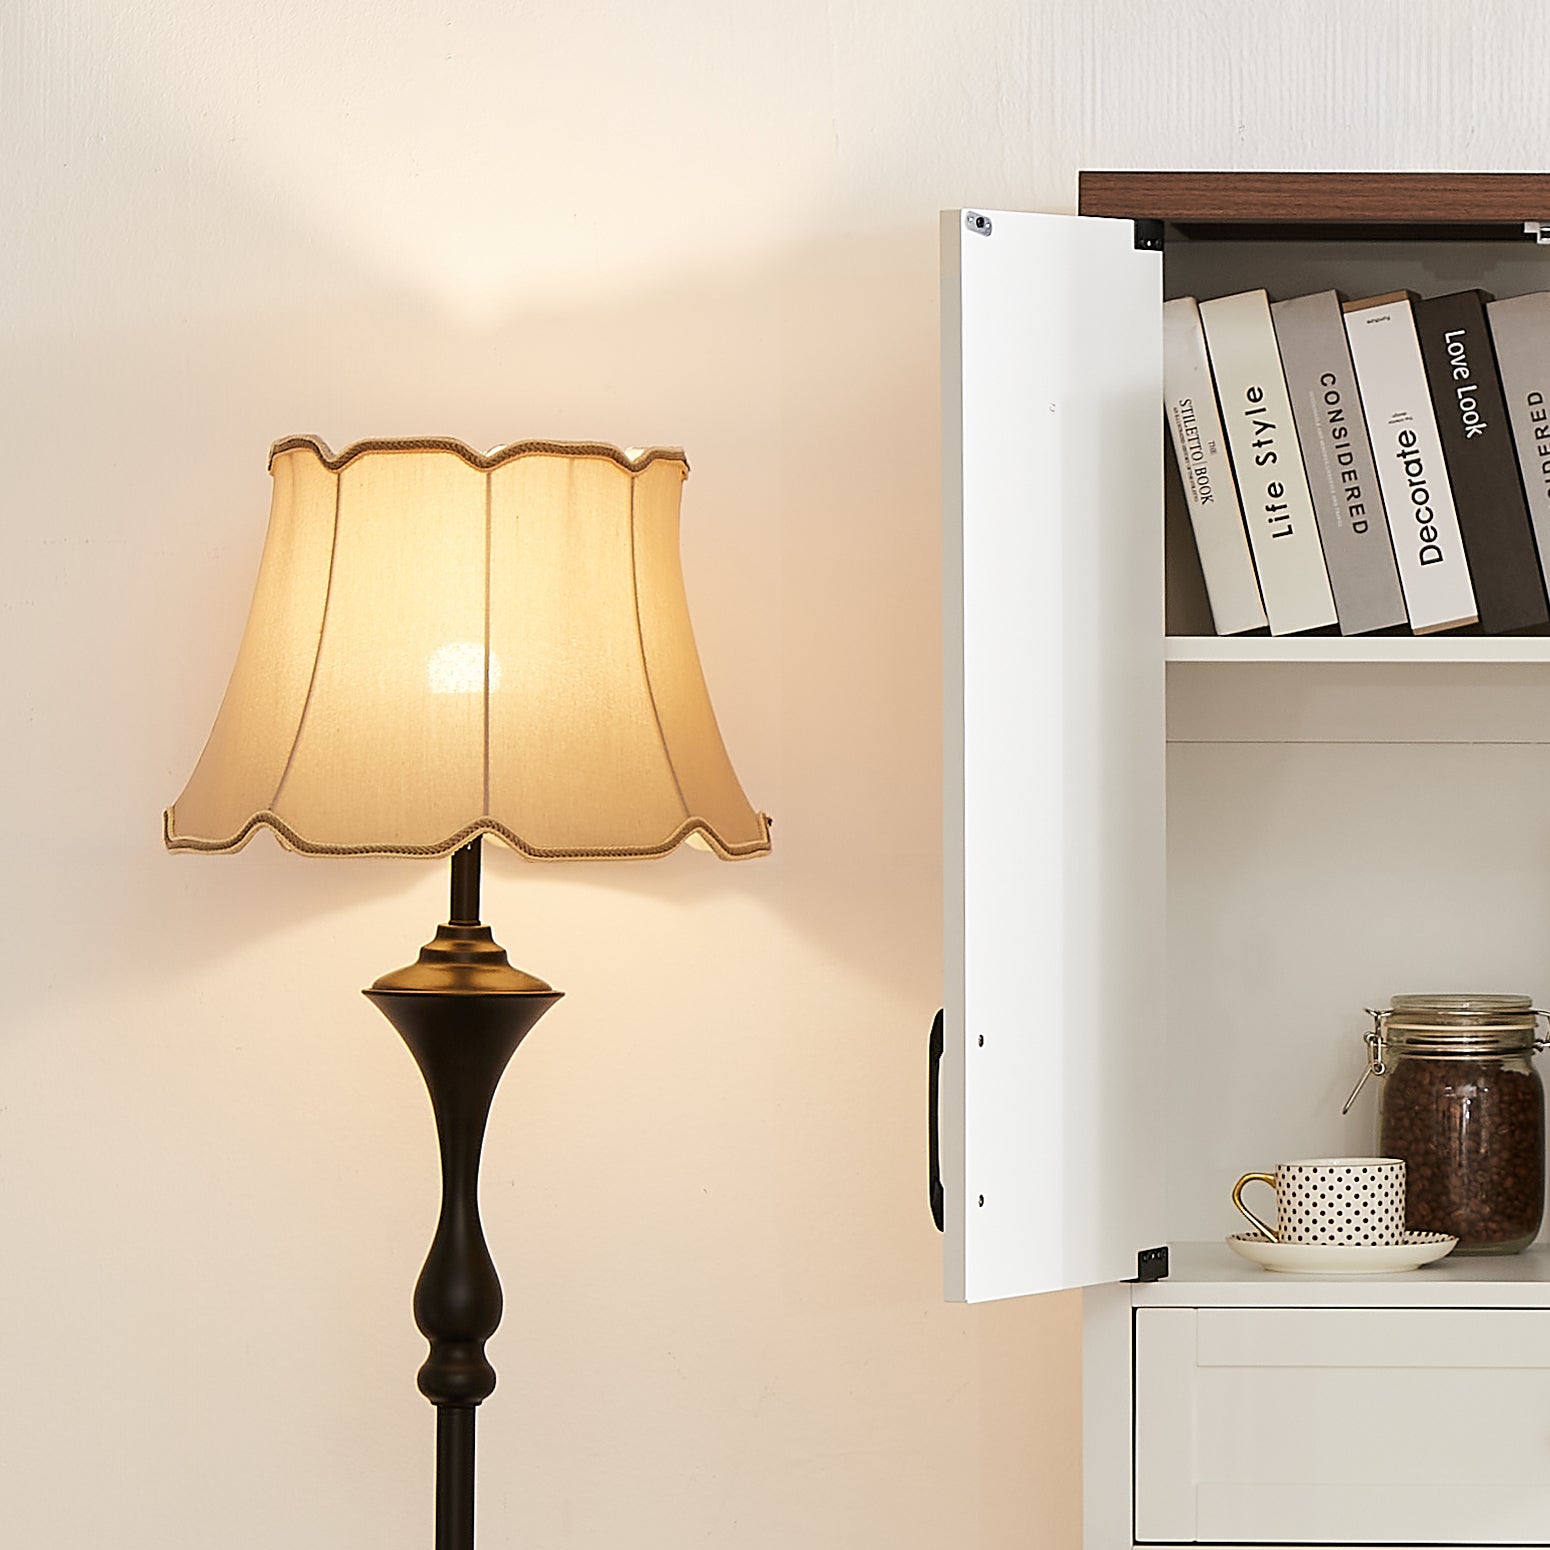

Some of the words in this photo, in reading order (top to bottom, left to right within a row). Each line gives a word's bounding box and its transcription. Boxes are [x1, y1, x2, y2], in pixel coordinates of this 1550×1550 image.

[1244, 386, 1278, 466] Style
[1444, 329, 1470, 380] Love
[1457, 385, 1488, 439] Look
[1178, 398, 1204, 461] STILETTO
[1195, 466, 1214, 505] BOOK
[1320, 372, 1369, 535] CONSIDERED
[1396, 429, 1444, 566] Decorate
[1265, 481, 1294, 539] Life
